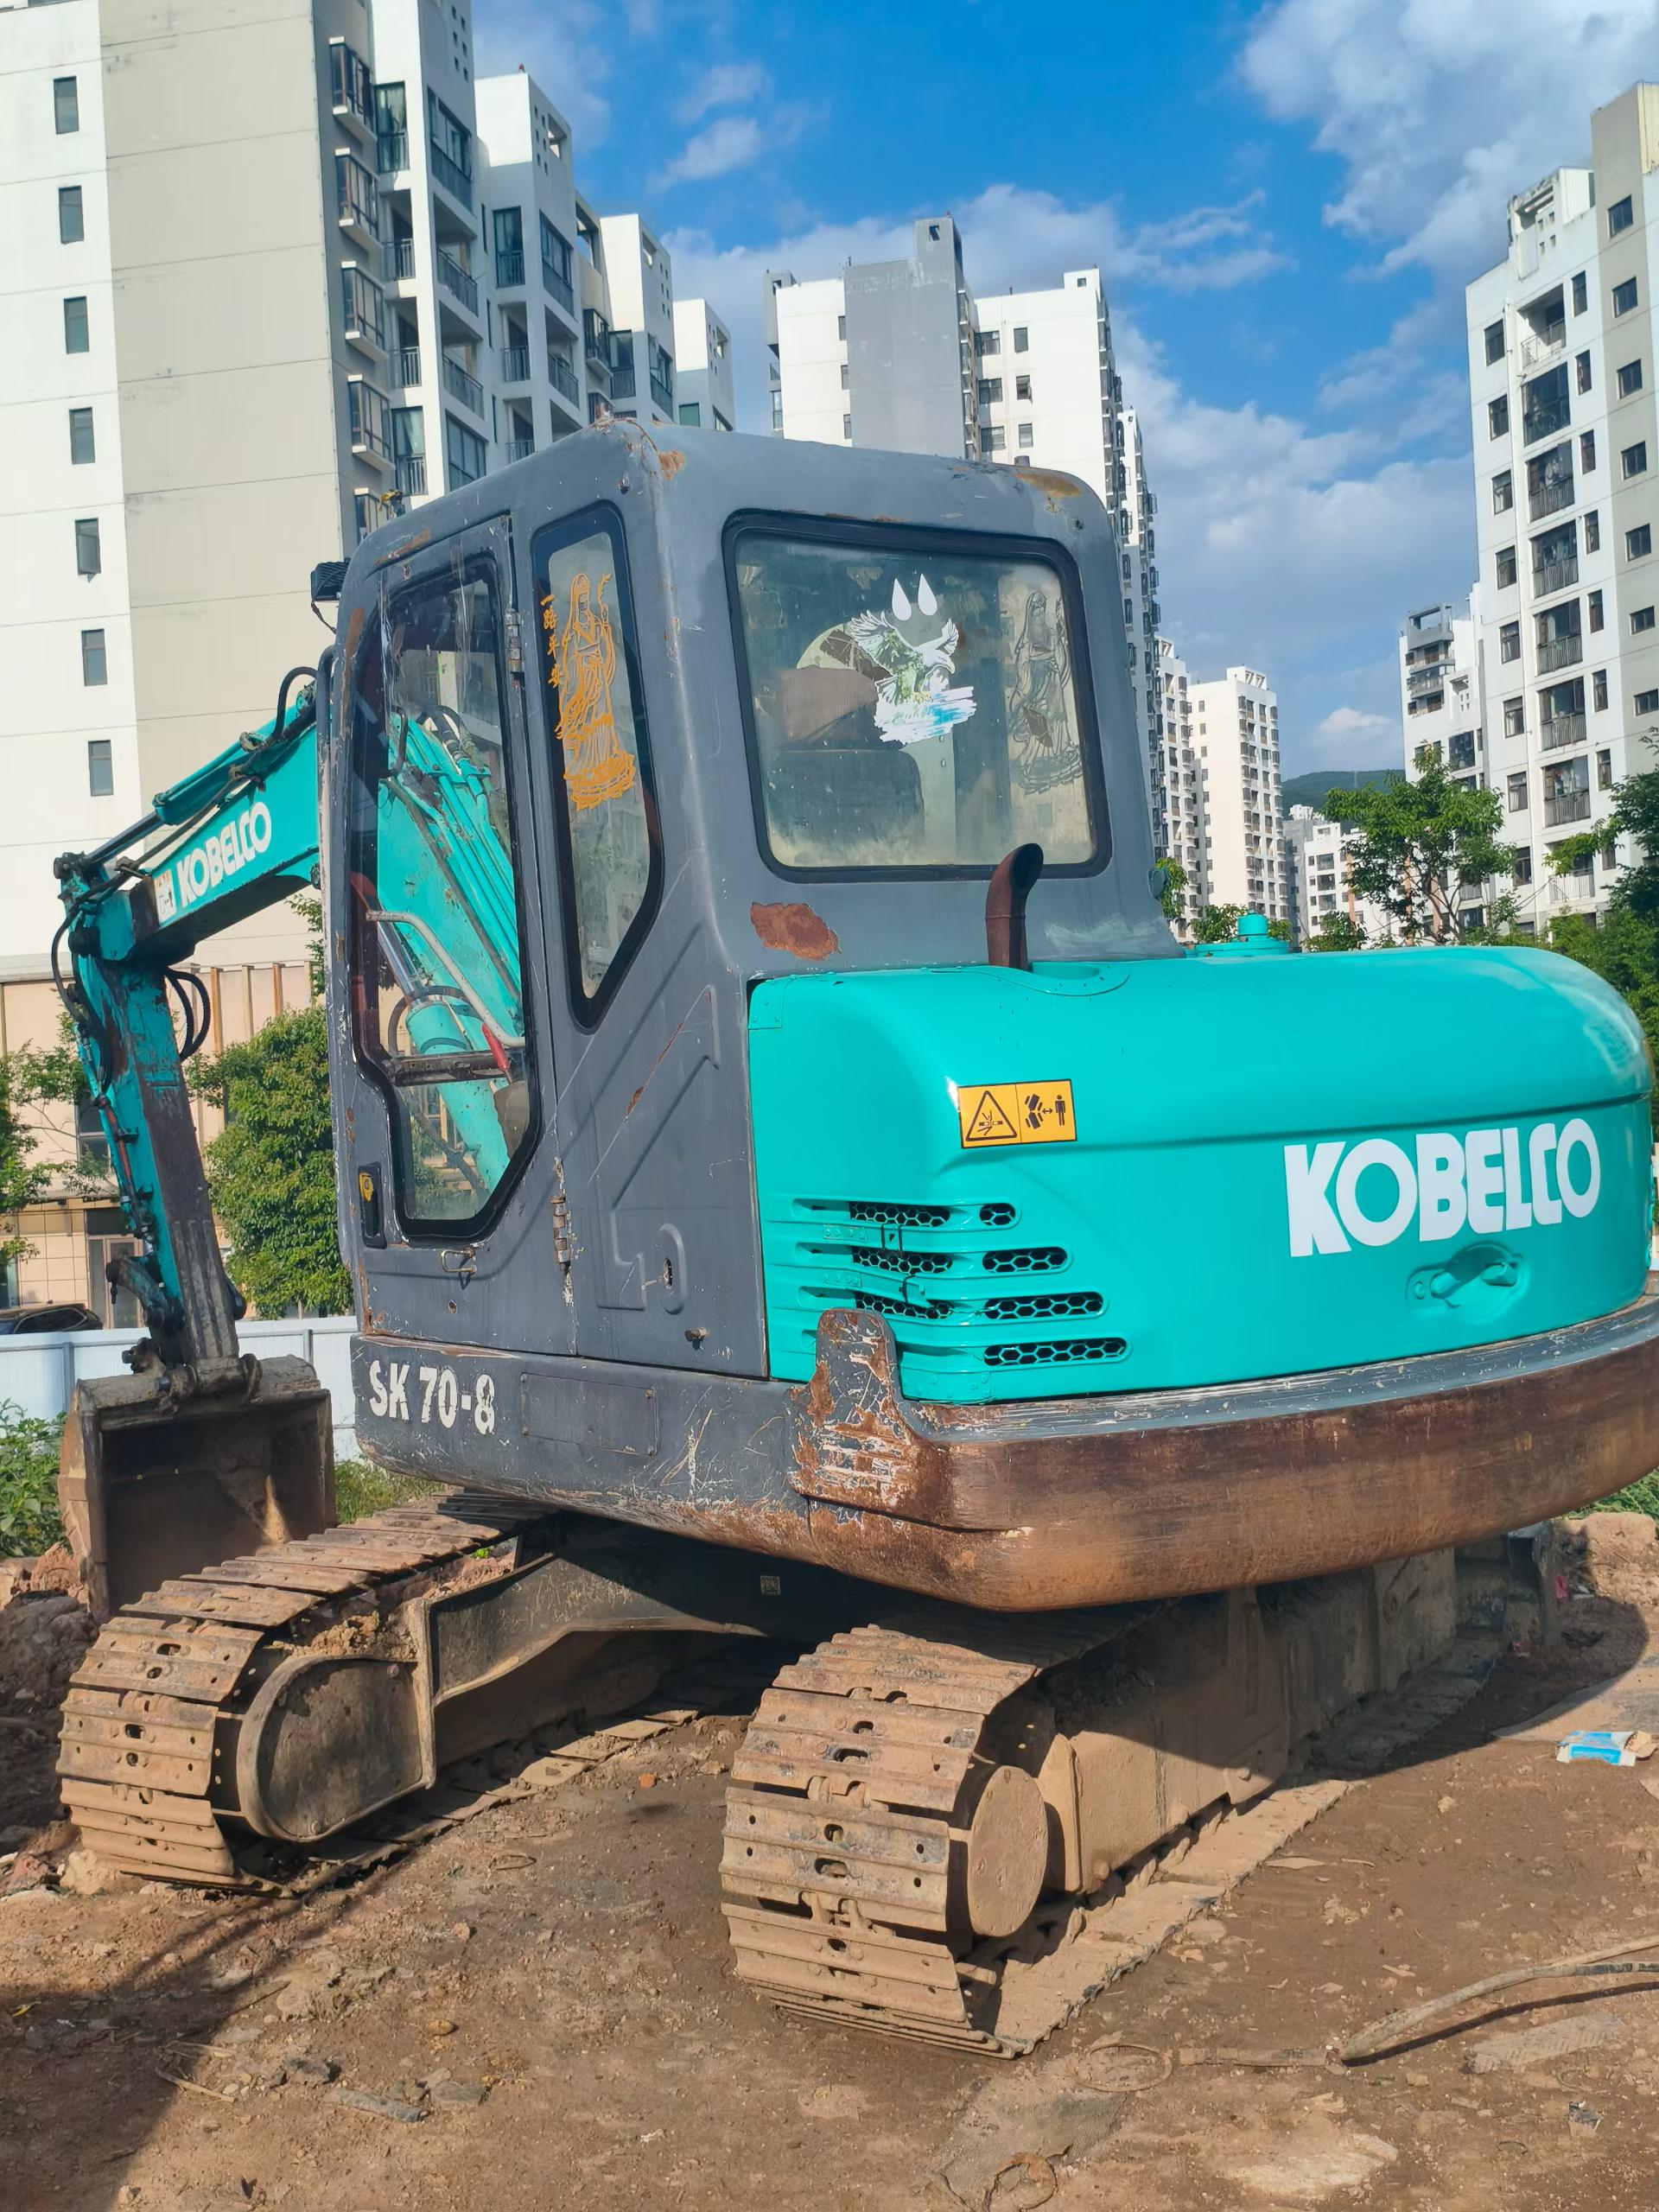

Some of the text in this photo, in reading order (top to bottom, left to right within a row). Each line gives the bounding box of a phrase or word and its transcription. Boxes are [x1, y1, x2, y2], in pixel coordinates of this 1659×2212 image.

[176, 802, 272, 907] KOBELCO
[1284, 1118, 1600, 1257] KOBELCO
[369, 1359, 495, 1435] SK 70-8
